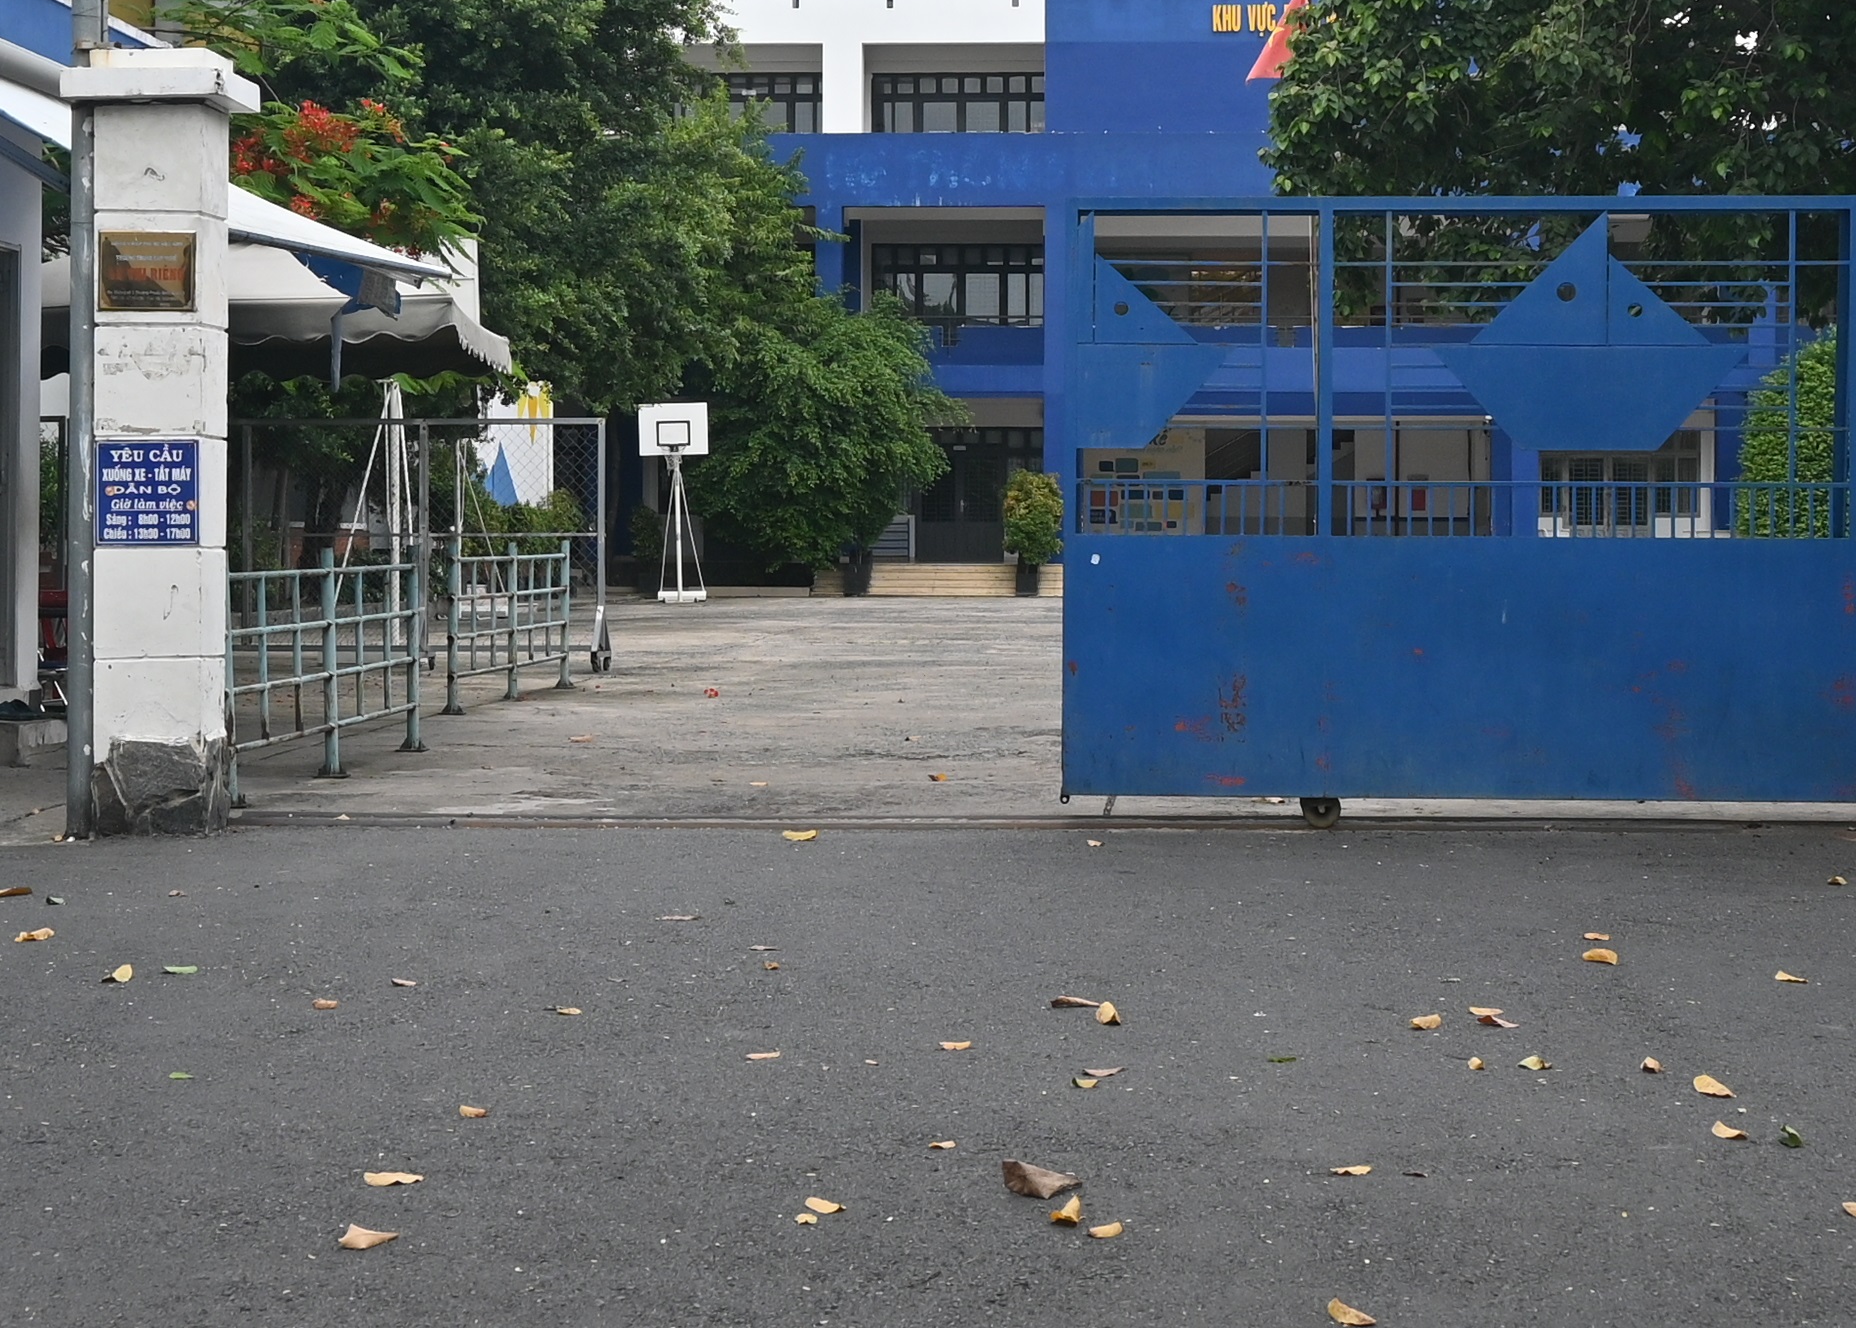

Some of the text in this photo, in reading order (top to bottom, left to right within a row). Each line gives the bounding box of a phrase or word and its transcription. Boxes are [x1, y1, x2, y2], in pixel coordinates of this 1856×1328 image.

[1213, 5, 1241, 32] KHU
[1248, 2, 1276, 37] VỰC
[110, 444, 183, 462] YÊU CẦU
[102, 464, 132, 481] XUỐNG
[134, 468, 146, 481] XE
[154, 464, 169, 481] TẮT
[172, 466, 191, 481] MÁY
[158, 484, 181, 495] BỘ
[111, 499, 183, 511] Giờ làm việc
